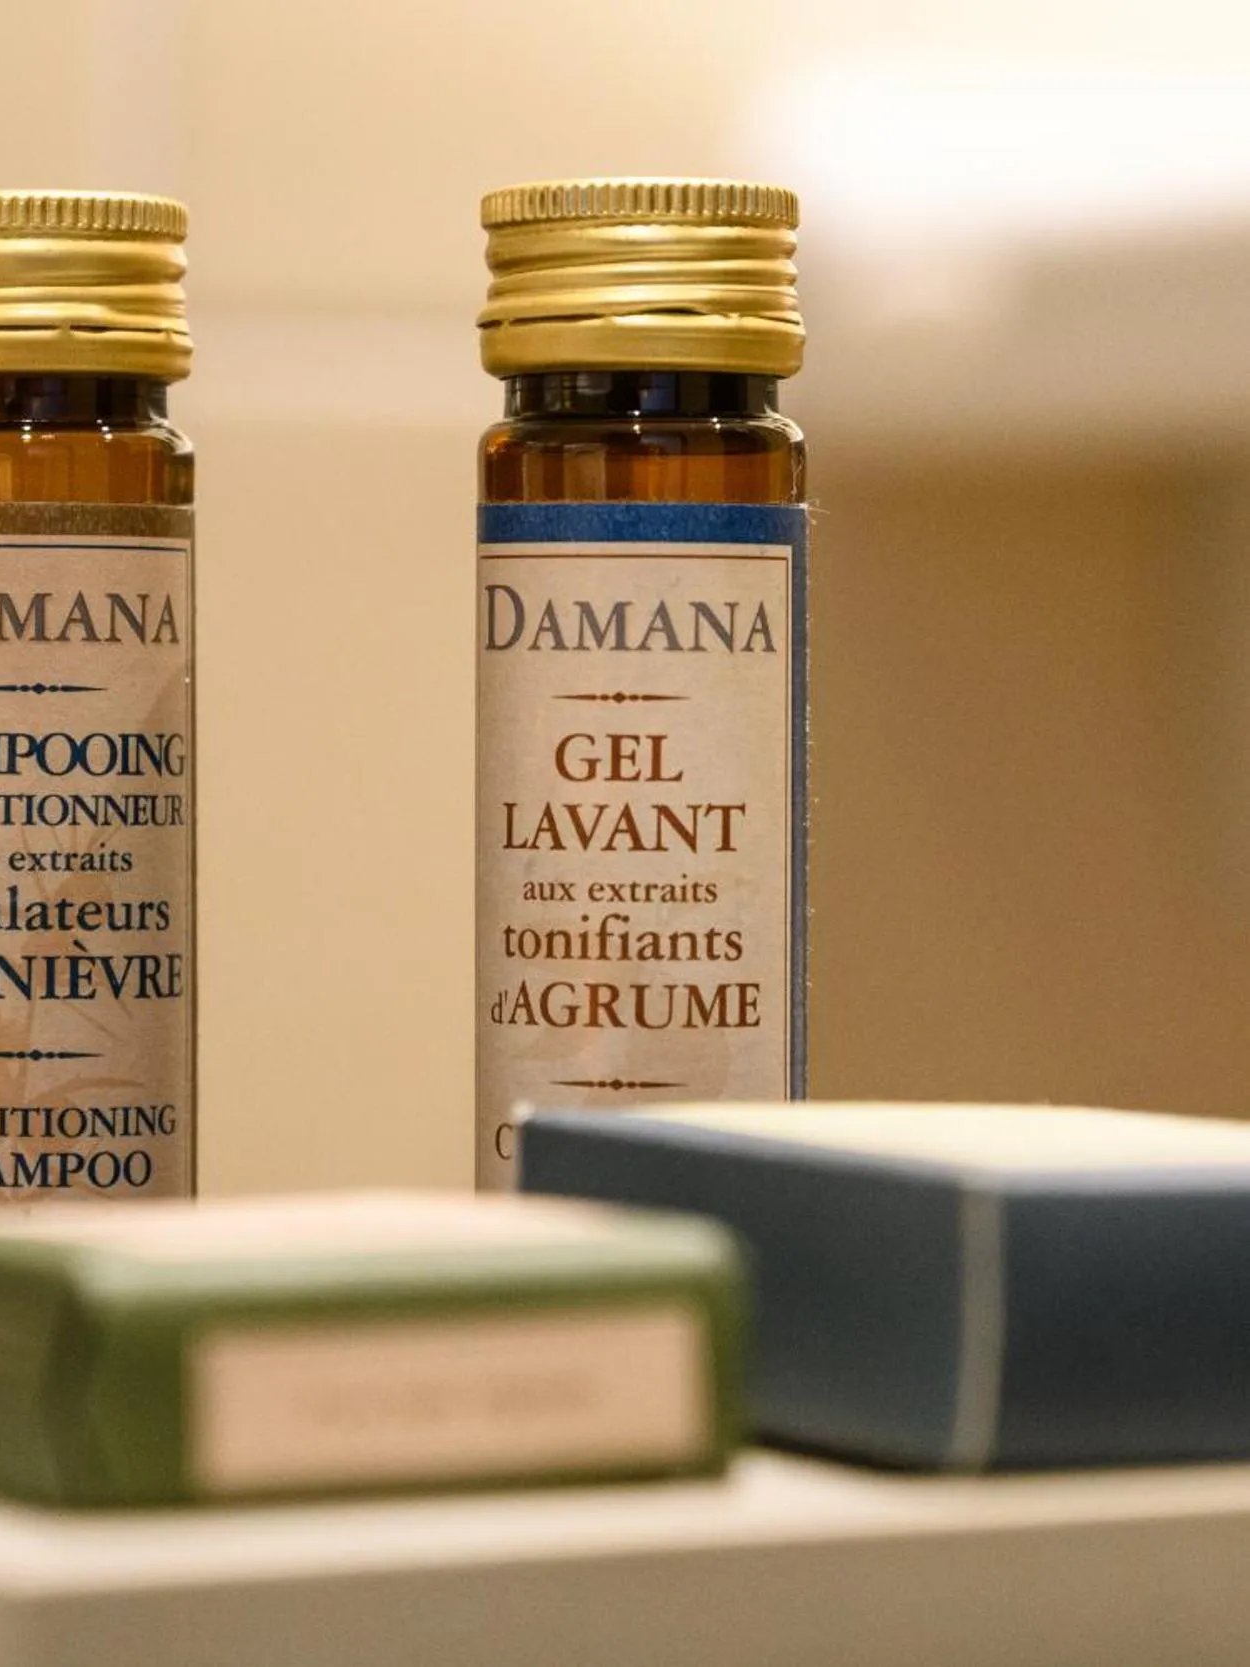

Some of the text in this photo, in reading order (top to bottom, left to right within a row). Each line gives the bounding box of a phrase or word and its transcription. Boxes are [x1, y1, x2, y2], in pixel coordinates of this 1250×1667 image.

[484, 584, 778, 654] DAMANA
[554, 732, 684, 783] GEL
[502, 801, 747, 854] LAVANT
[8, 842, 133, 872] extraits
[522, 873, 718, 903] aux extraits
[503, 913, 744, 962] tonifiants
[490, 980, 762, 1030] d'AGRUME
